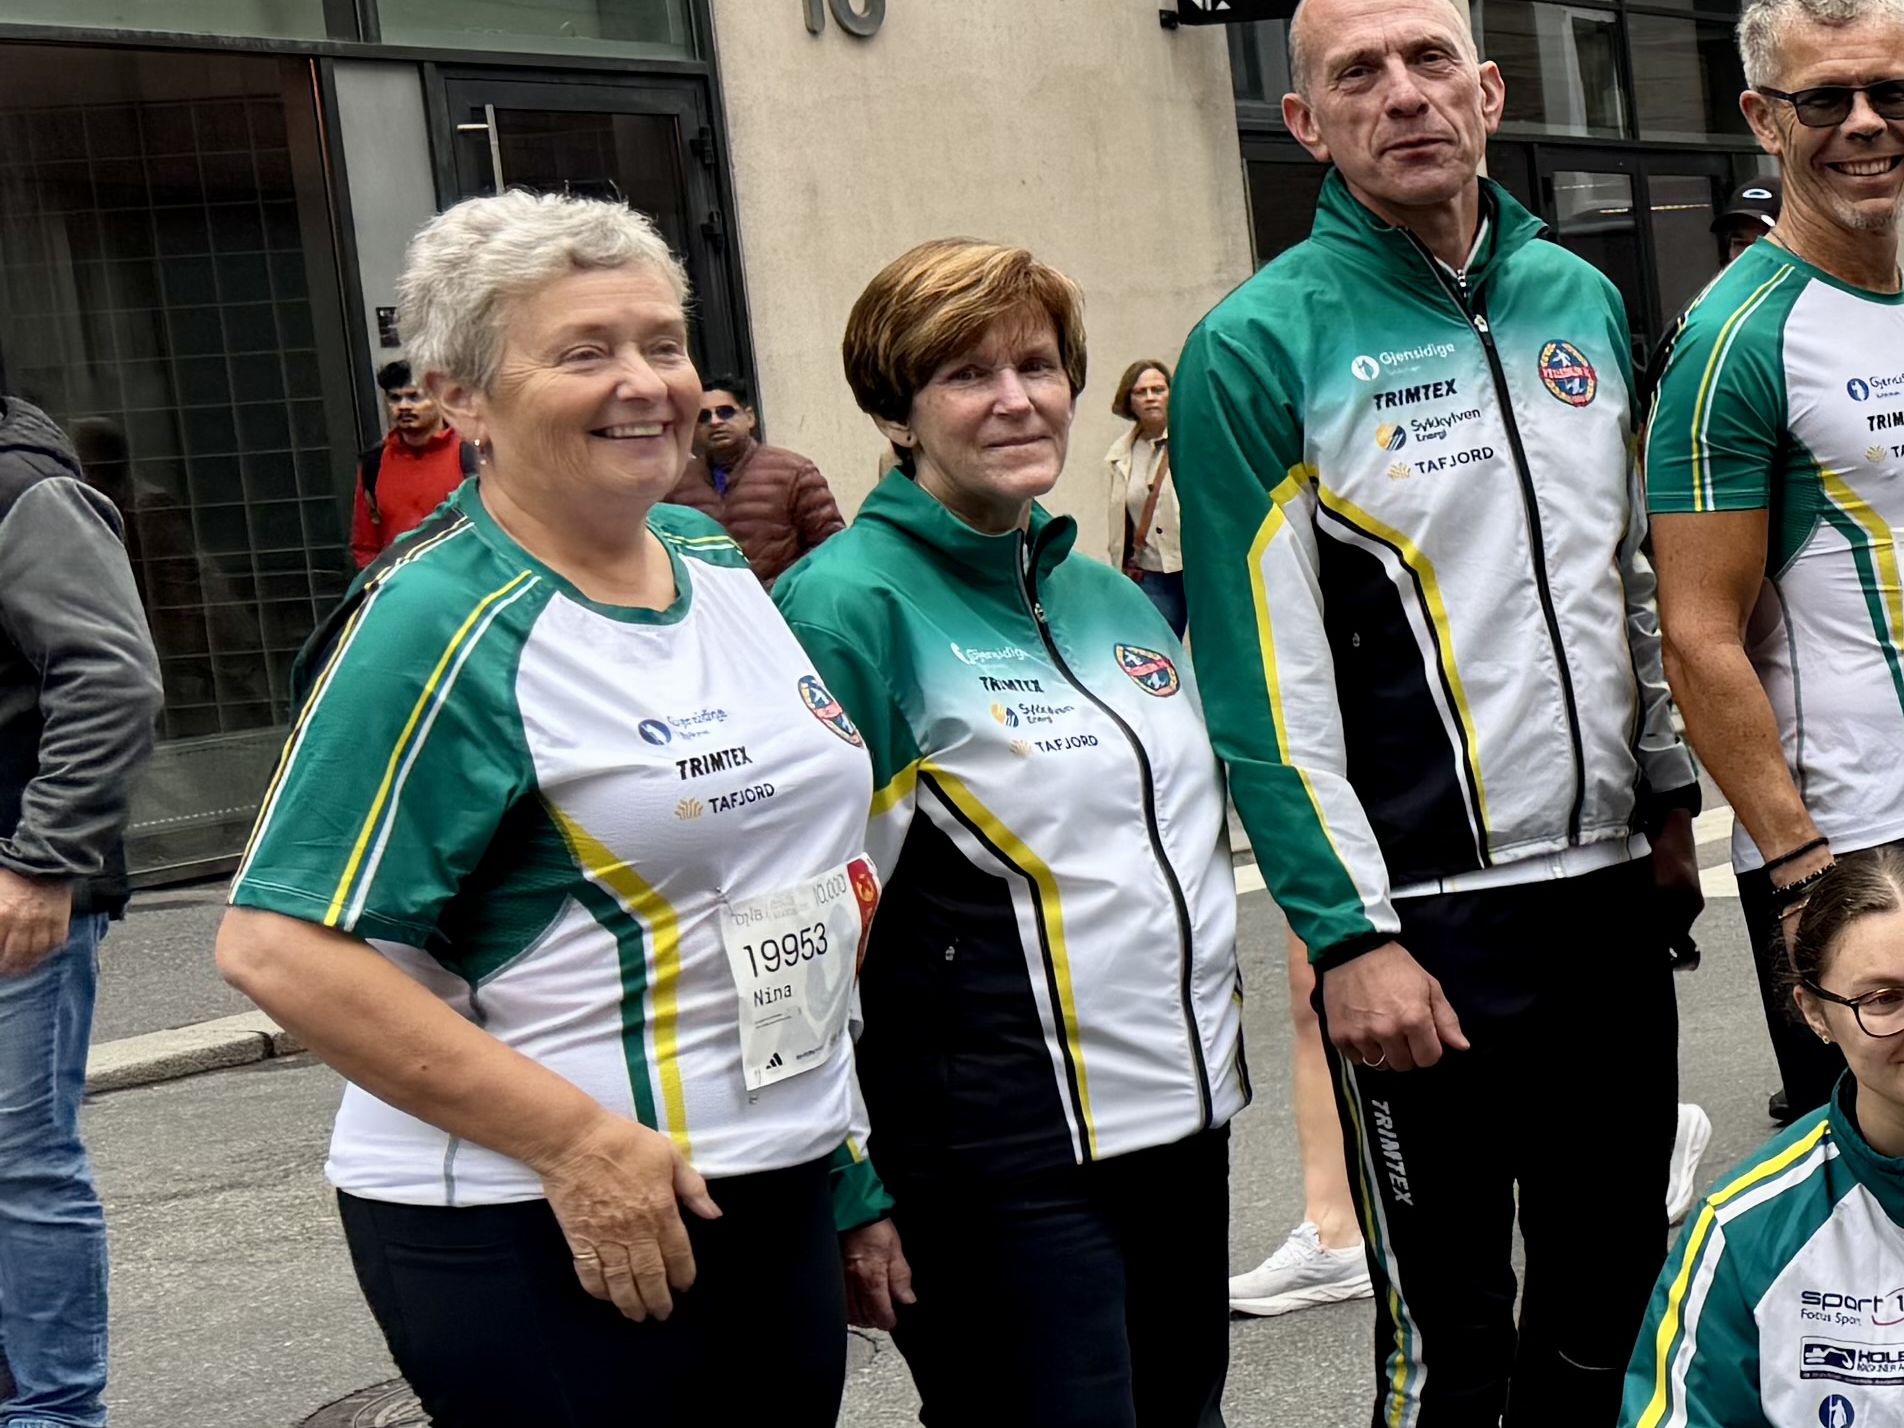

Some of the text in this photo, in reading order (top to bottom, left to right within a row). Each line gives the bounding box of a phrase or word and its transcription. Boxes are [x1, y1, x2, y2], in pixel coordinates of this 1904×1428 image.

[1373, 378, 1458, 411] TRIMTEX
[1415, 446, 1494, 475] TAFJORD
[1035, 735, 1098, 753] TAFJORD
[676, 745, 753, 781] TRIMTEX
[708, 782, 775, 815] TAFJORD
[742, 922, 829, 978] 19953
[753, 983, 793, 1009] Nina
[1371, 1099, 1414, 1206] TRIMTEX
[1801, 1290, 1904, 1313] sport 1
